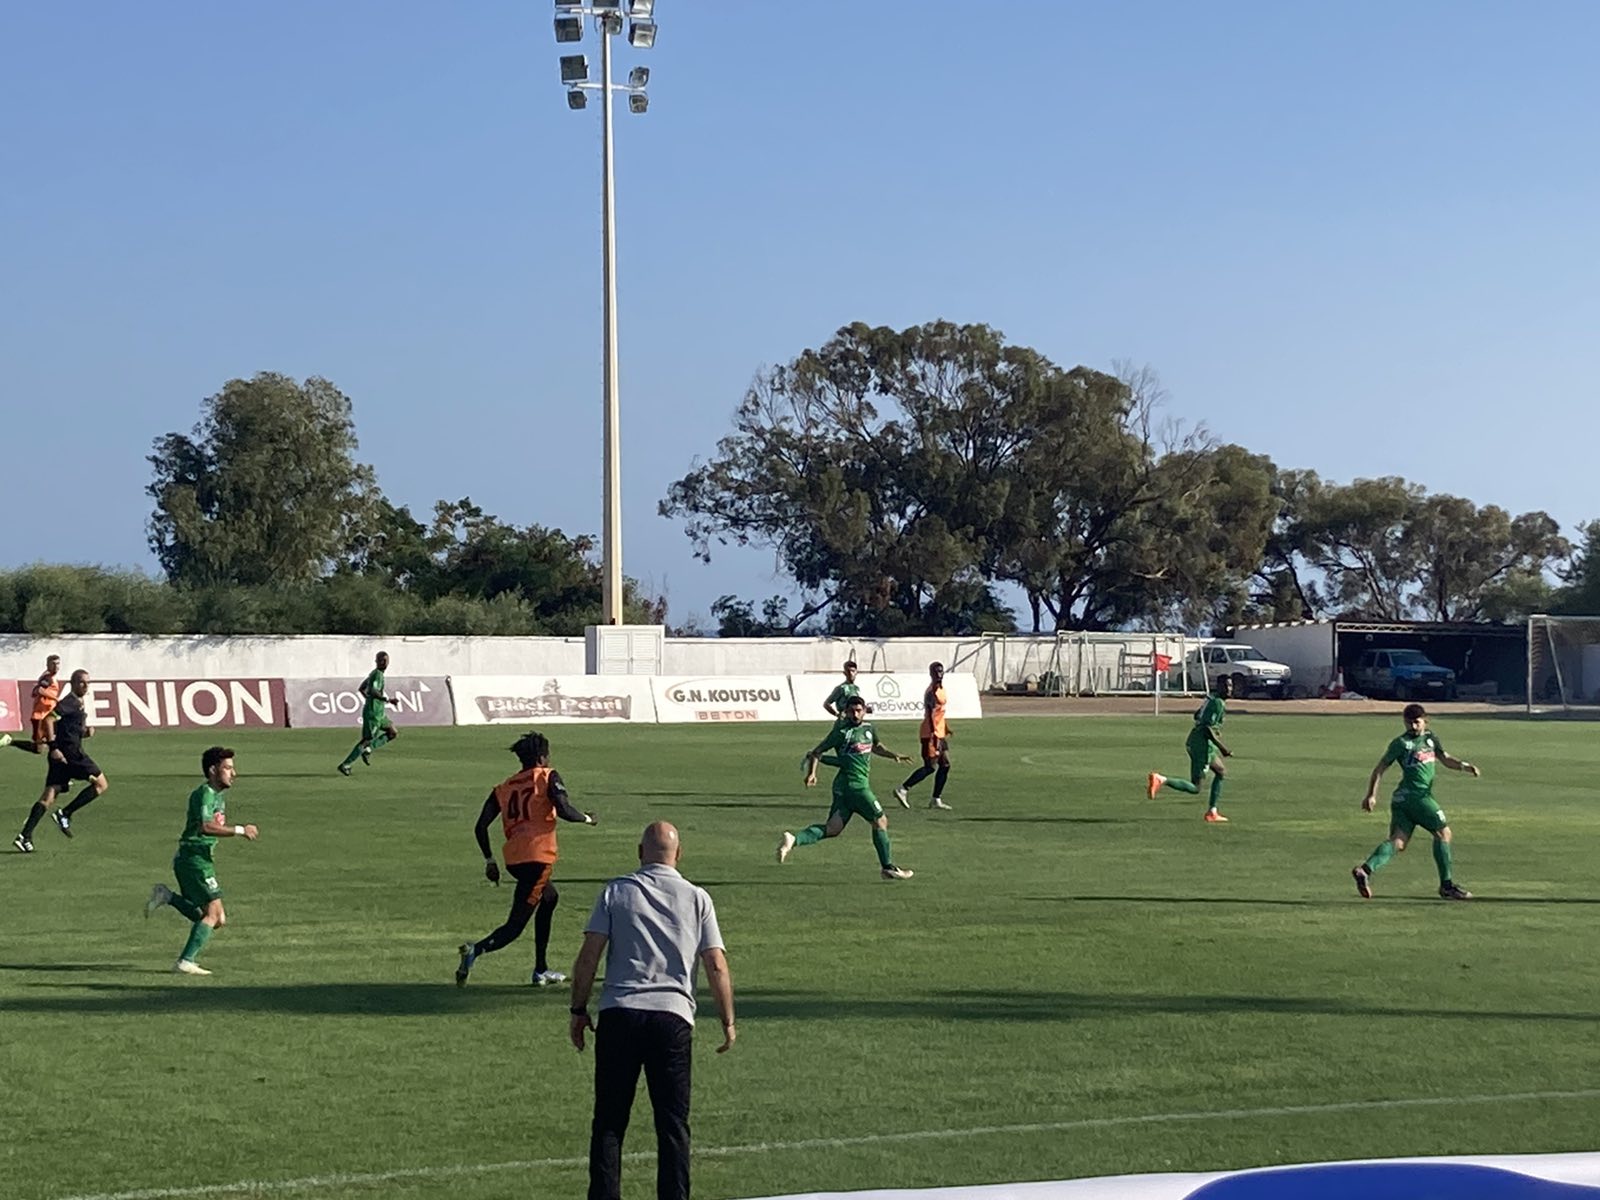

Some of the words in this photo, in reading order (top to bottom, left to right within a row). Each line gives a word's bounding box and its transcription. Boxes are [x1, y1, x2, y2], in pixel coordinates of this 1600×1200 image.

[487, 699, 552, 712] Black
[560, 698, 623, 711] Pearl
[698, 710, 757, 720] BETON
